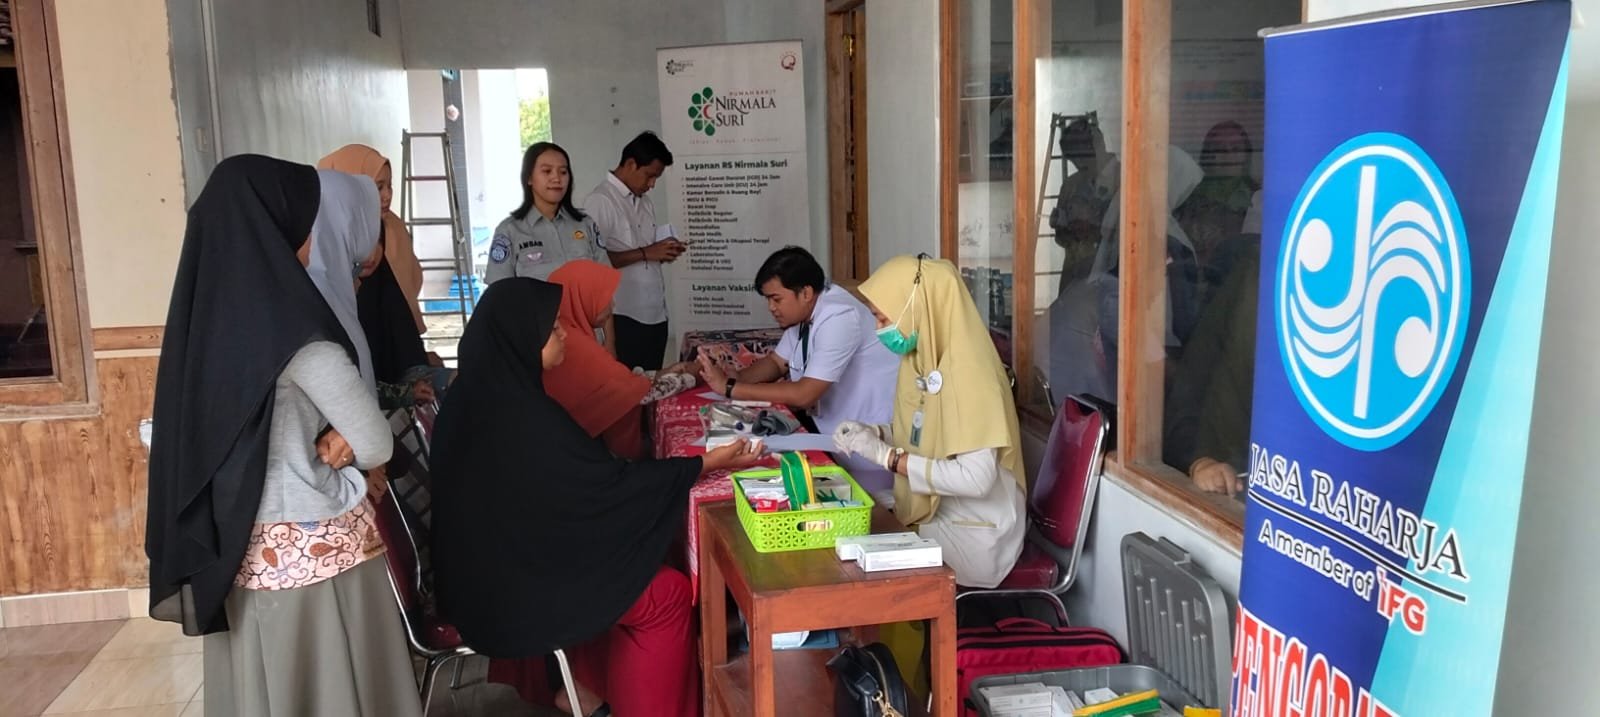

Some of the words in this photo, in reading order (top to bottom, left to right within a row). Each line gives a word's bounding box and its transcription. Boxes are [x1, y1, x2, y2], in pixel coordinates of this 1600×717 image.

[716, 96, 776, 115] NIRMALA
[716, 112, 744, 127] SURI
[685, 162, 720, 171] Layanan
[722, 161, 733, 169] RS
[734, 160, 768, 169] Nirmala
[770, 158, 787, 168] Suri
[692, 284, 727, 292] Layanan
[1249, 443, 1306, 507] JASA
[1310, 468, 1470, 582] RAHARJA
[1258, 518, 1274, 549] A
[1274, 528, 1353, 588] member
[1353, 570, 1374, 602] of
